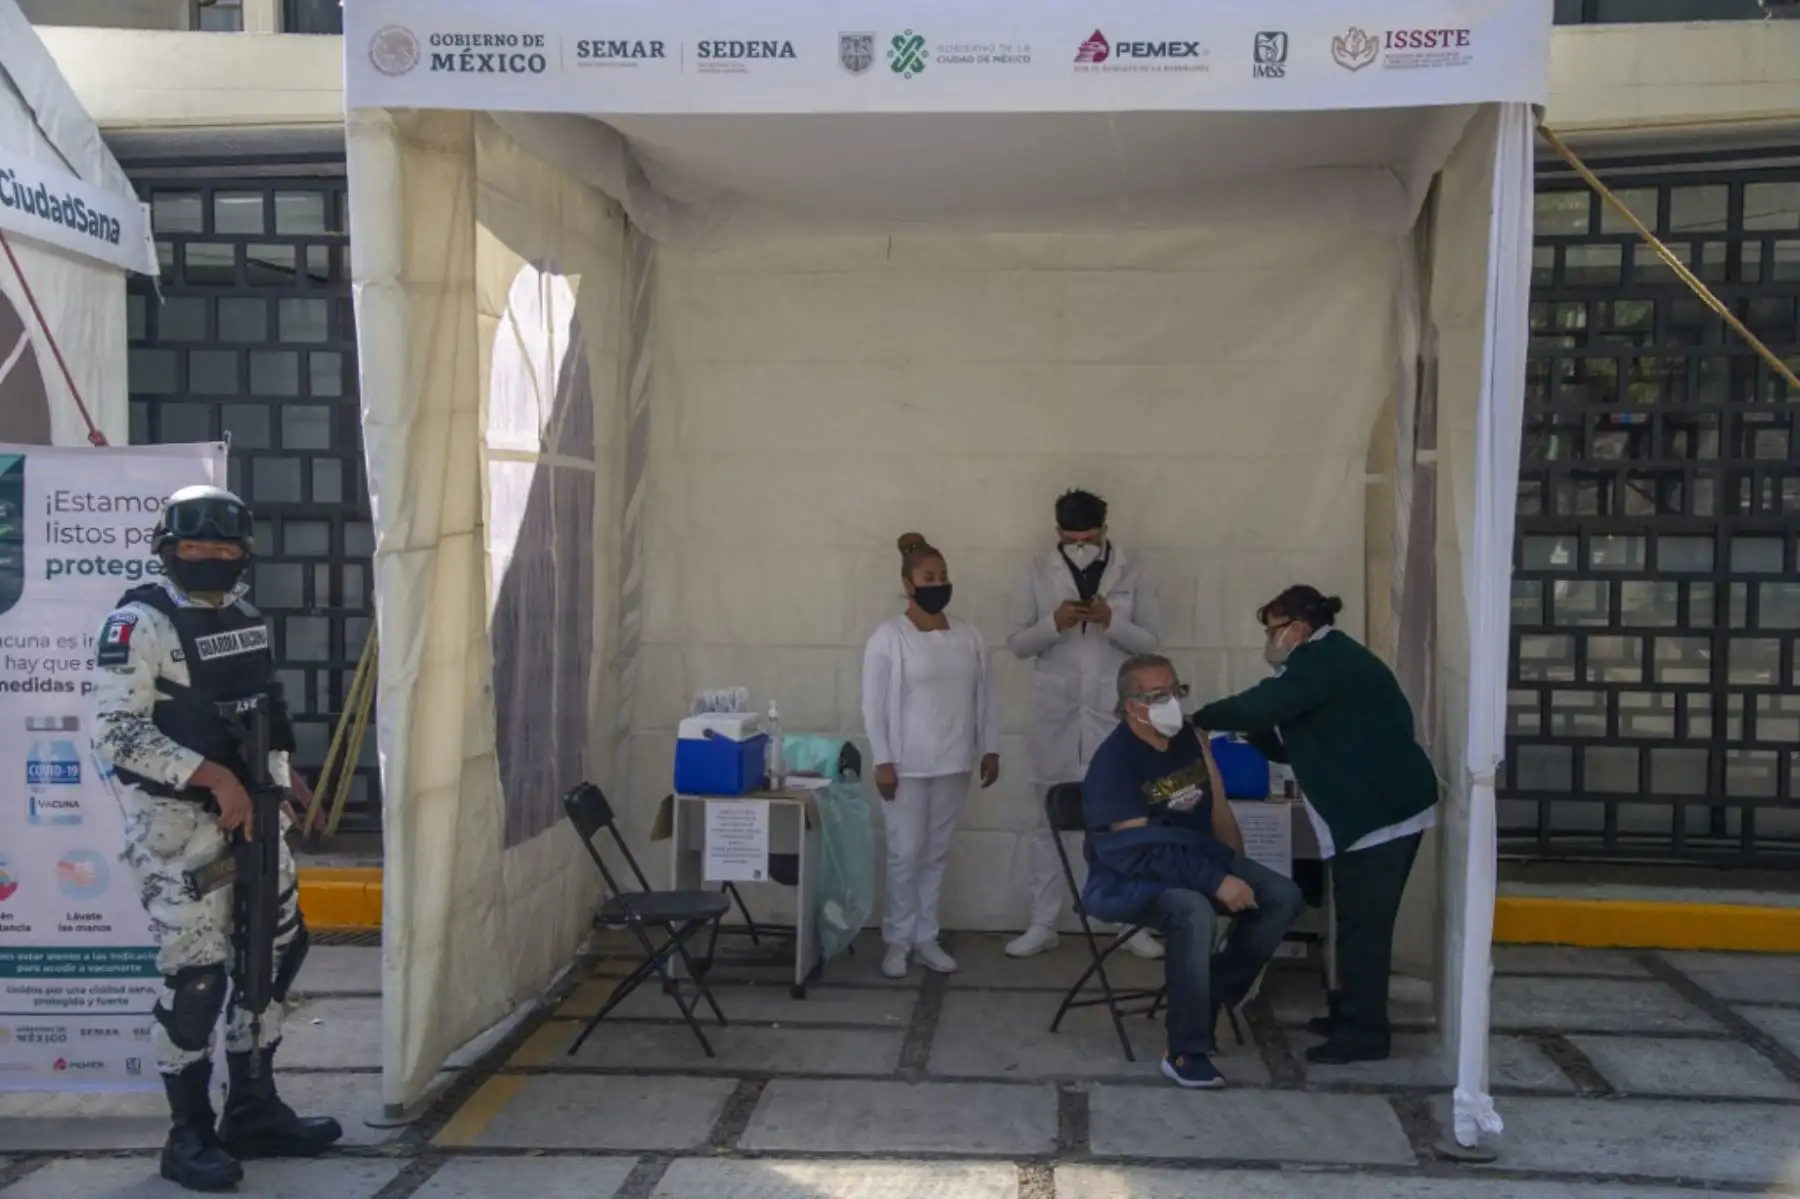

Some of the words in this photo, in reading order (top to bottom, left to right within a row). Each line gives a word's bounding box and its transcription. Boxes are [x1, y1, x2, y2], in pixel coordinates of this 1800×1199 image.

[430, 33, 518, 47] GOBIERNO
[522, 34, 545, 47] DE
[1384, 29, 1471, 49] ISSSTE
[577, 40, 666, 59] SEMAR
[697, 40, 797, 59] SEDENA
[1116, 41, 1200, 58] PEMEX
[430, 47, 546, 73] MÉXICO
[1253, 62, 1286, 78] IMSS
[0, 168, 120, 245] CiudadSana
[46, 521, 116, 544] listos
[57, 636, 78, 649] es
[5, 654, 38, 675] hay
[43, 658, 81, 674] que
[29, 764, 78, 778] COVID-19
[37, 799, 80, 809] VACUNA
